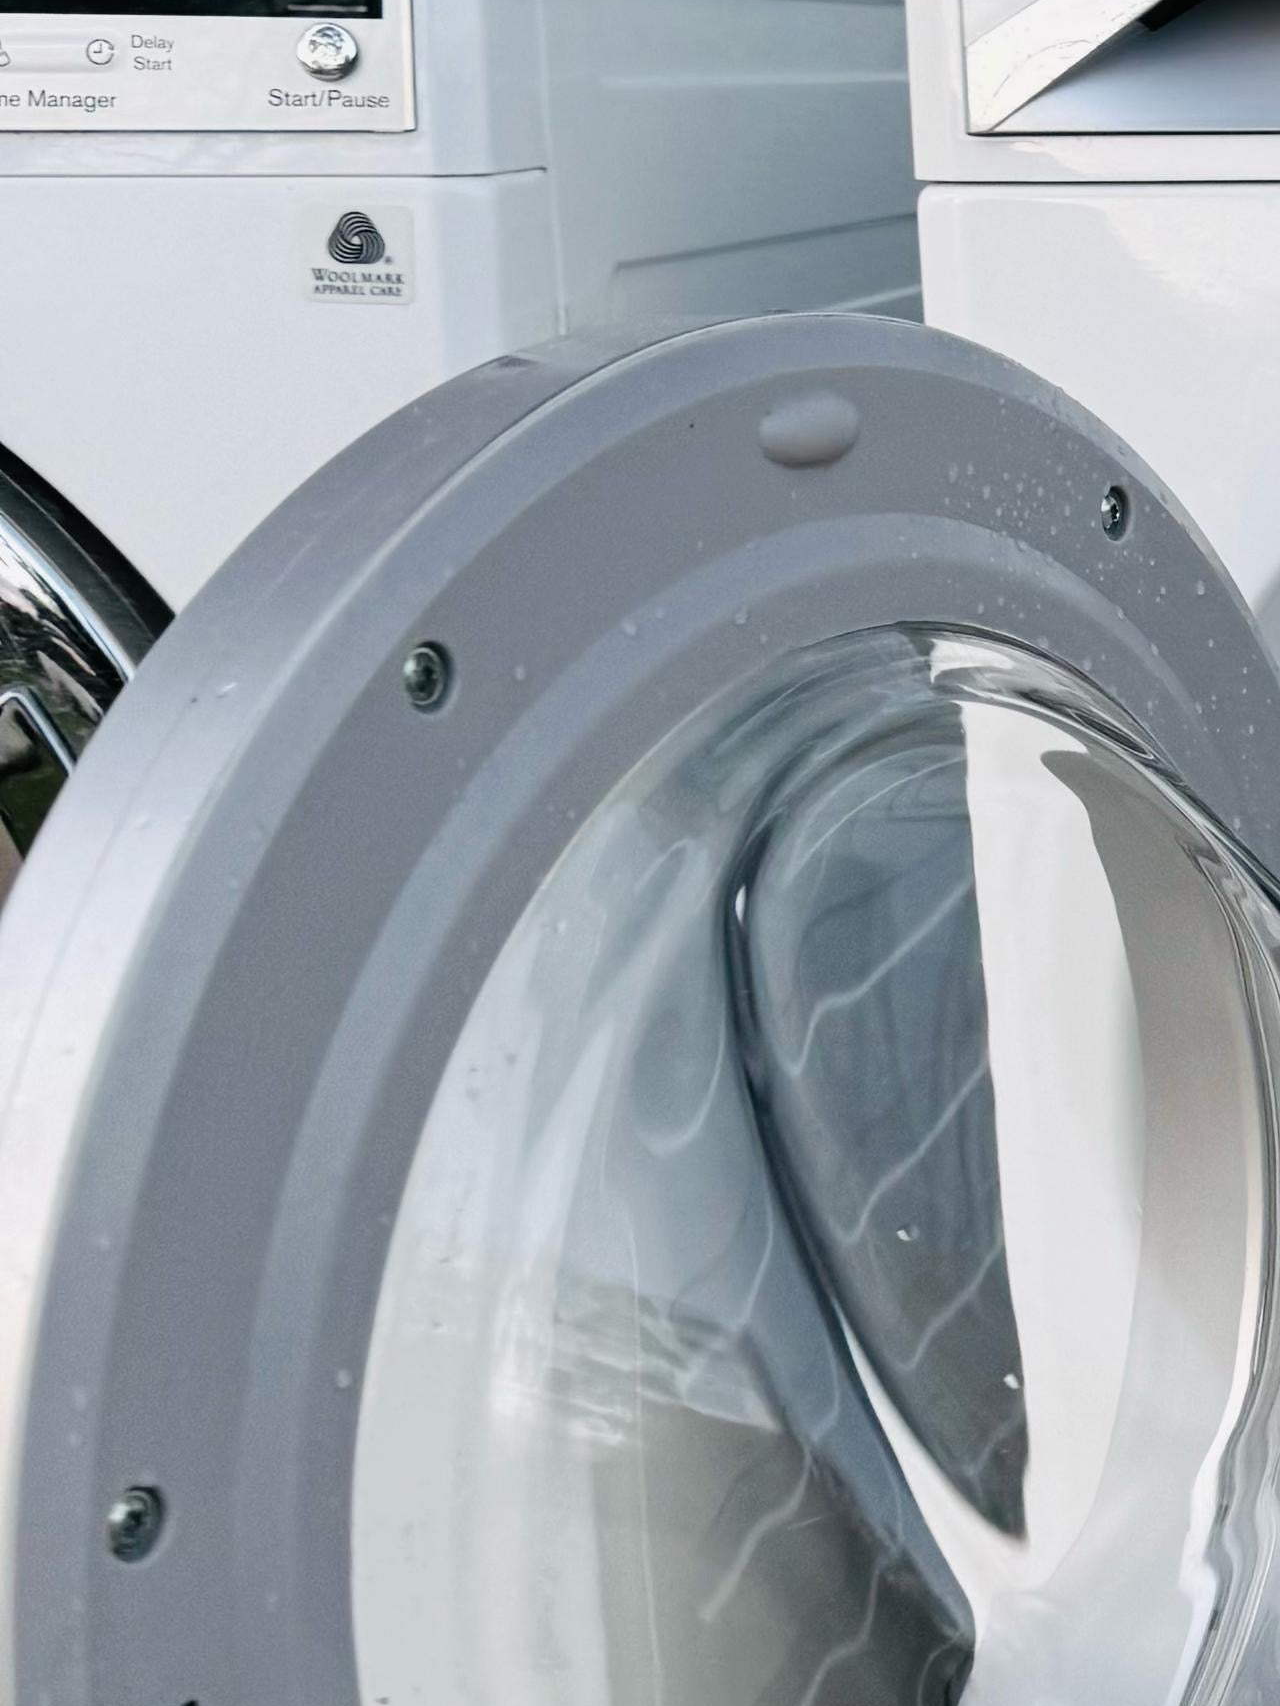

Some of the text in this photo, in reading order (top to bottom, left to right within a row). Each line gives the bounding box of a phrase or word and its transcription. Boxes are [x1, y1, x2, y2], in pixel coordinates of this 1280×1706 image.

[130, 35, 174, 51] Delay
[134, 57, 172, 71] Start
[28, 89, 117, 112] Manager
[268, 89, 390, 108] Start/Pause
[311, 268, 405, 285] WOOLMARK
